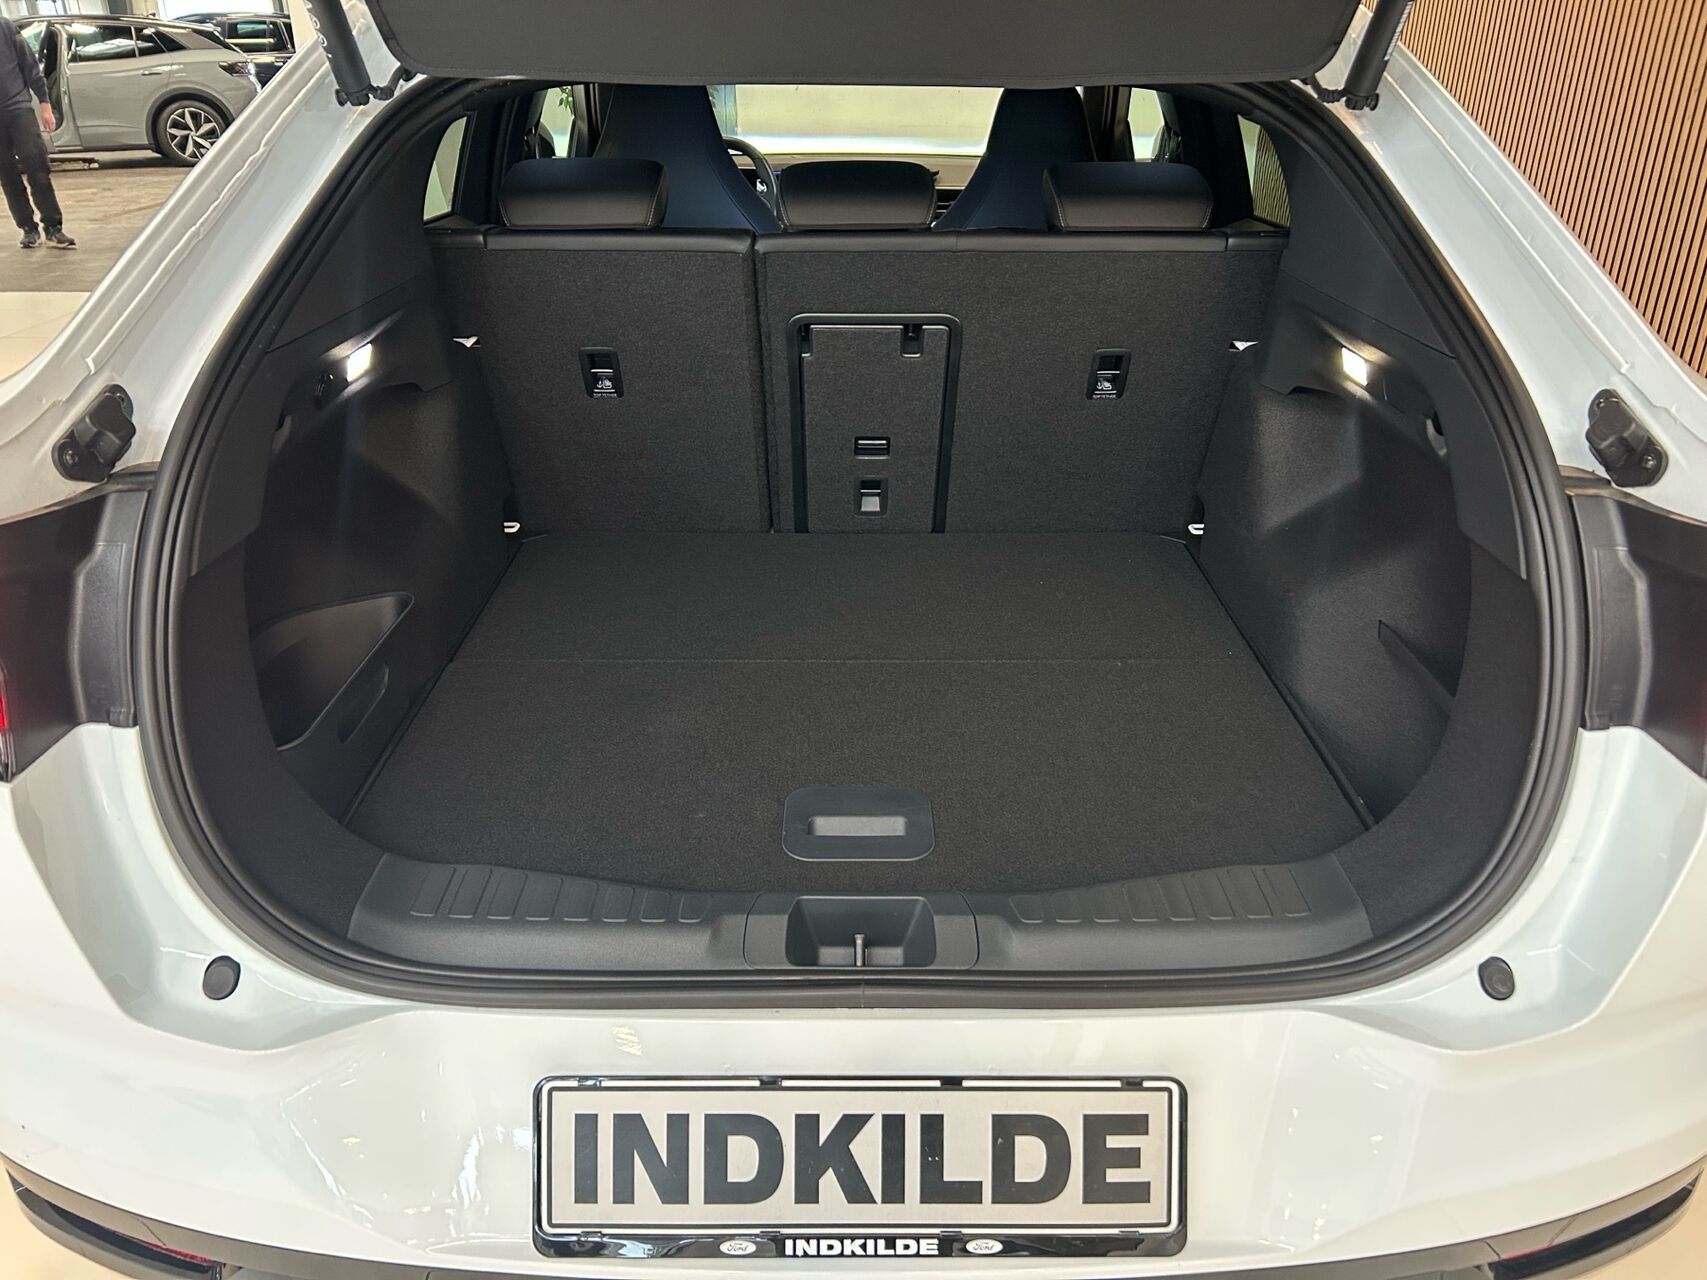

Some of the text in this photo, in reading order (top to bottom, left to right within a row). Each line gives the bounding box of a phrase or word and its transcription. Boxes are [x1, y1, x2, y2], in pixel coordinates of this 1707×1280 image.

[574, 1113, 1151, 1205] INDKILDE
[727, 1242, 749, 1253] Ford
[785, 1239, 938, 1256] INDKILDE
[973, 1241, 995, 1252] Ford
